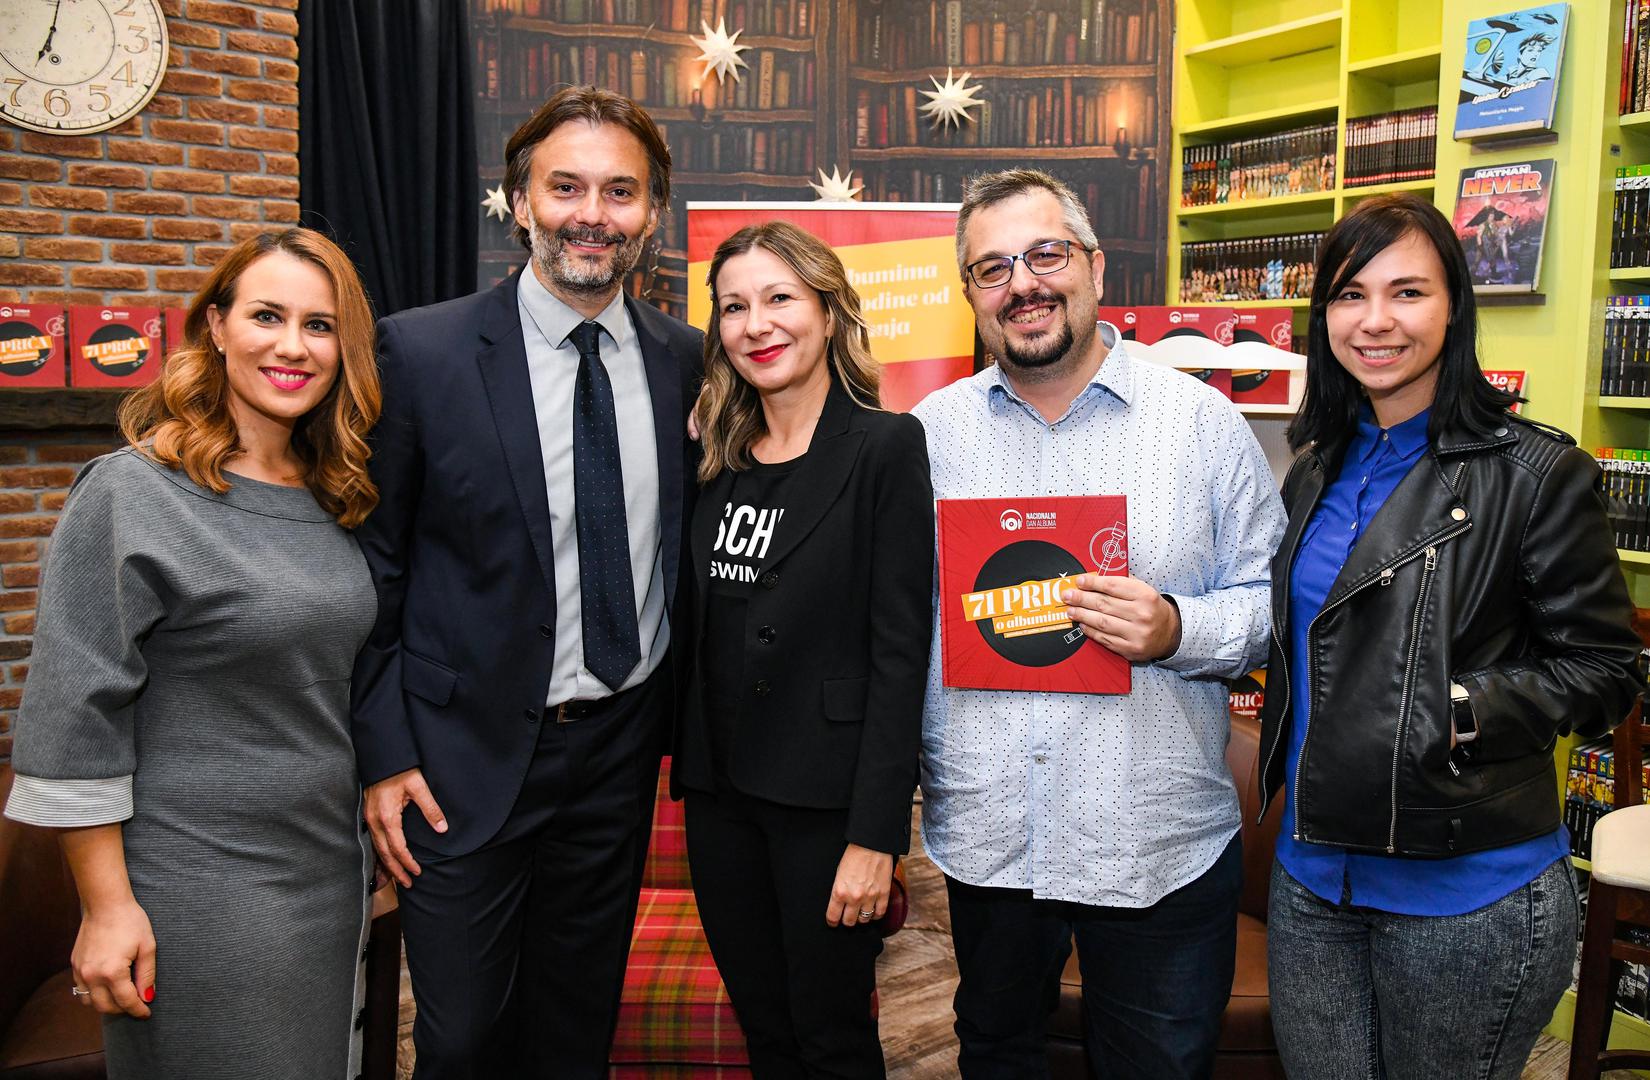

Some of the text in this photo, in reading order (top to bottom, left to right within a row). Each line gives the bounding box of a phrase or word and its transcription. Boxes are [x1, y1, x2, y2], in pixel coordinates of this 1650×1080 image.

[124, 25, 149, 54] 3
[111, 60, 138, 88] 4
[4, 78, 27, 107] 7
[44, 88, 71, 117] 6
[88, 85, 112, 112] 5
[1463, 172, 1541, 196] NEVER
[1477, 166, 1529, 179] NATHAN
[922, 286, 950, 305] od
[1026, 512, 1057, 520] NACIONALNI
[968, 591, 996, 618] 71
[996, 621, 1004, 630] o
